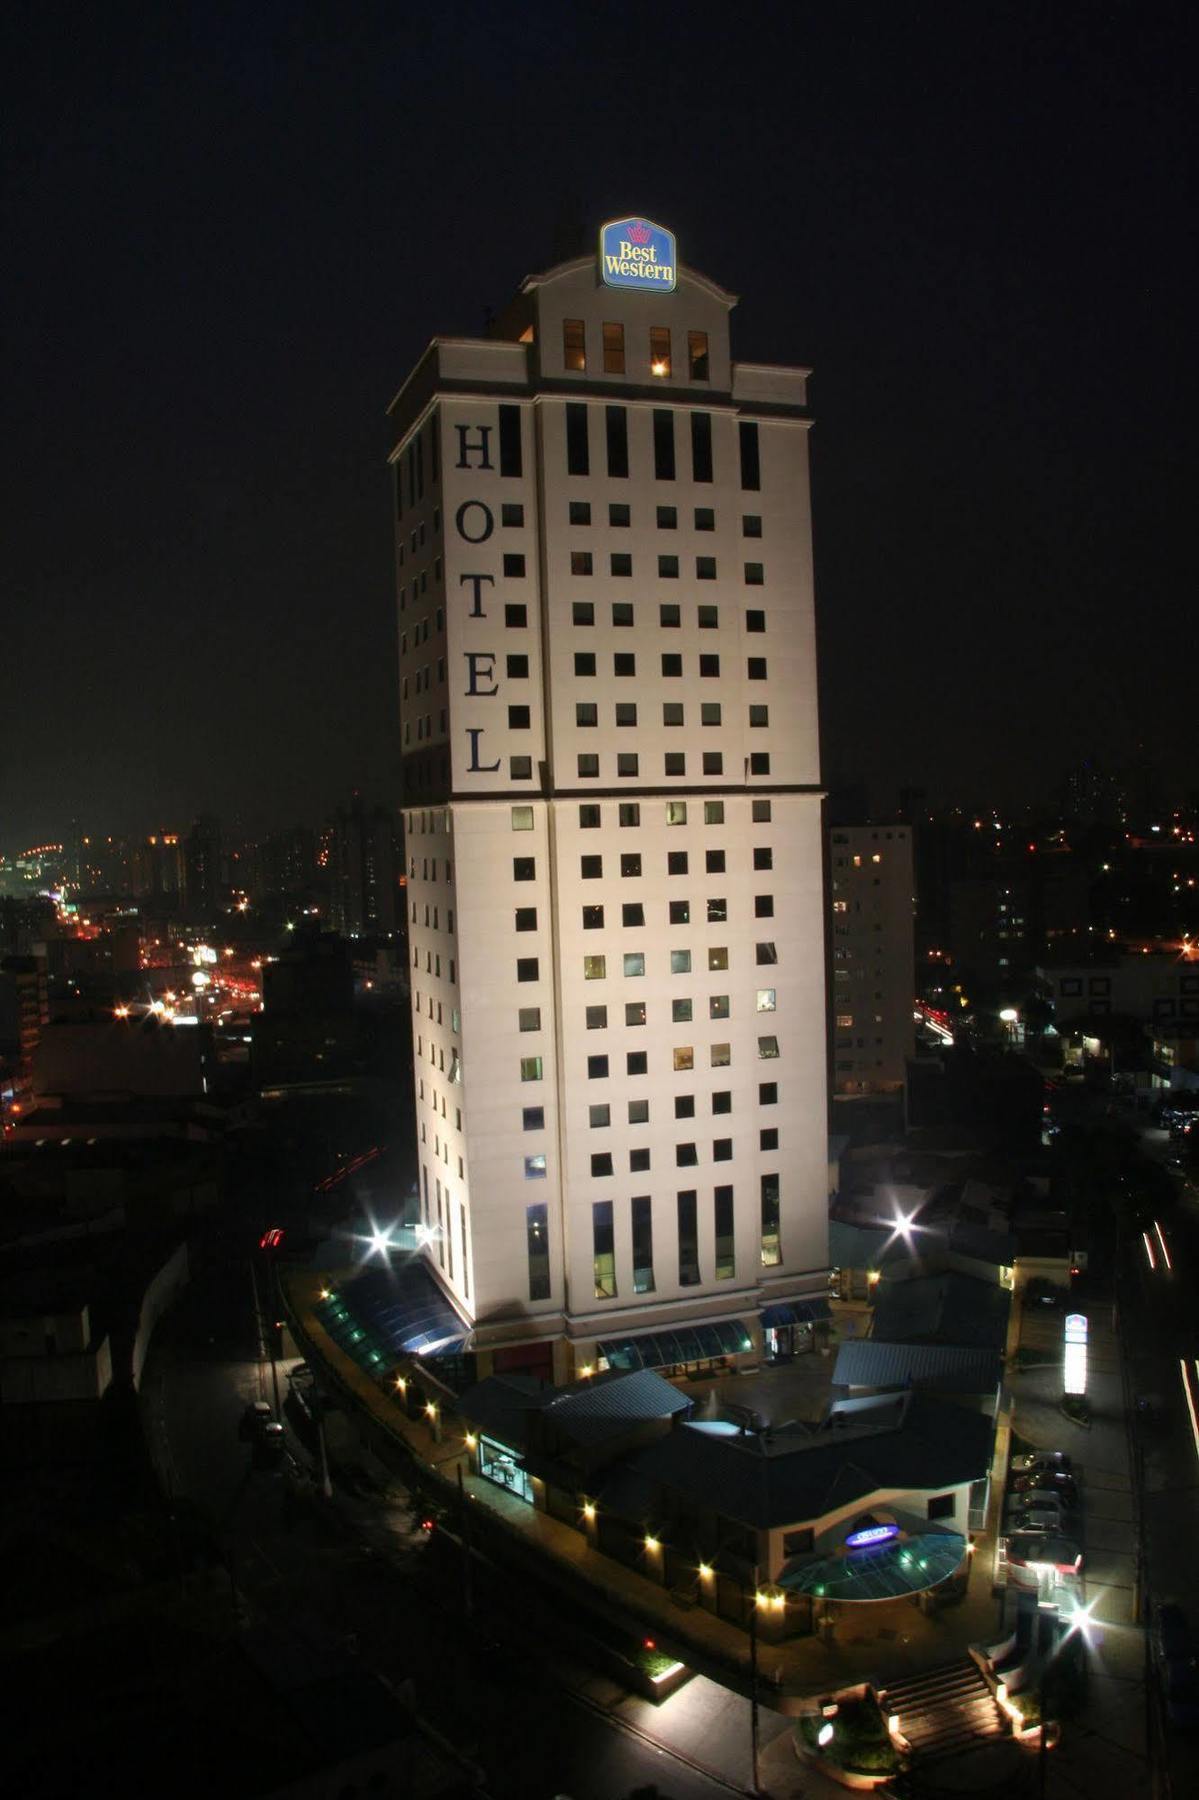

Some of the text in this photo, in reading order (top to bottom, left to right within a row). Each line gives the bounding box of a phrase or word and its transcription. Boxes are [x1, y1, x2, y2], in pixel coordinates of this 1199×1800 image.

[620, 241, 657, 262] Best
[605, 256, 673, 280] Western
[455, 425, 501, 772] HOTEL
